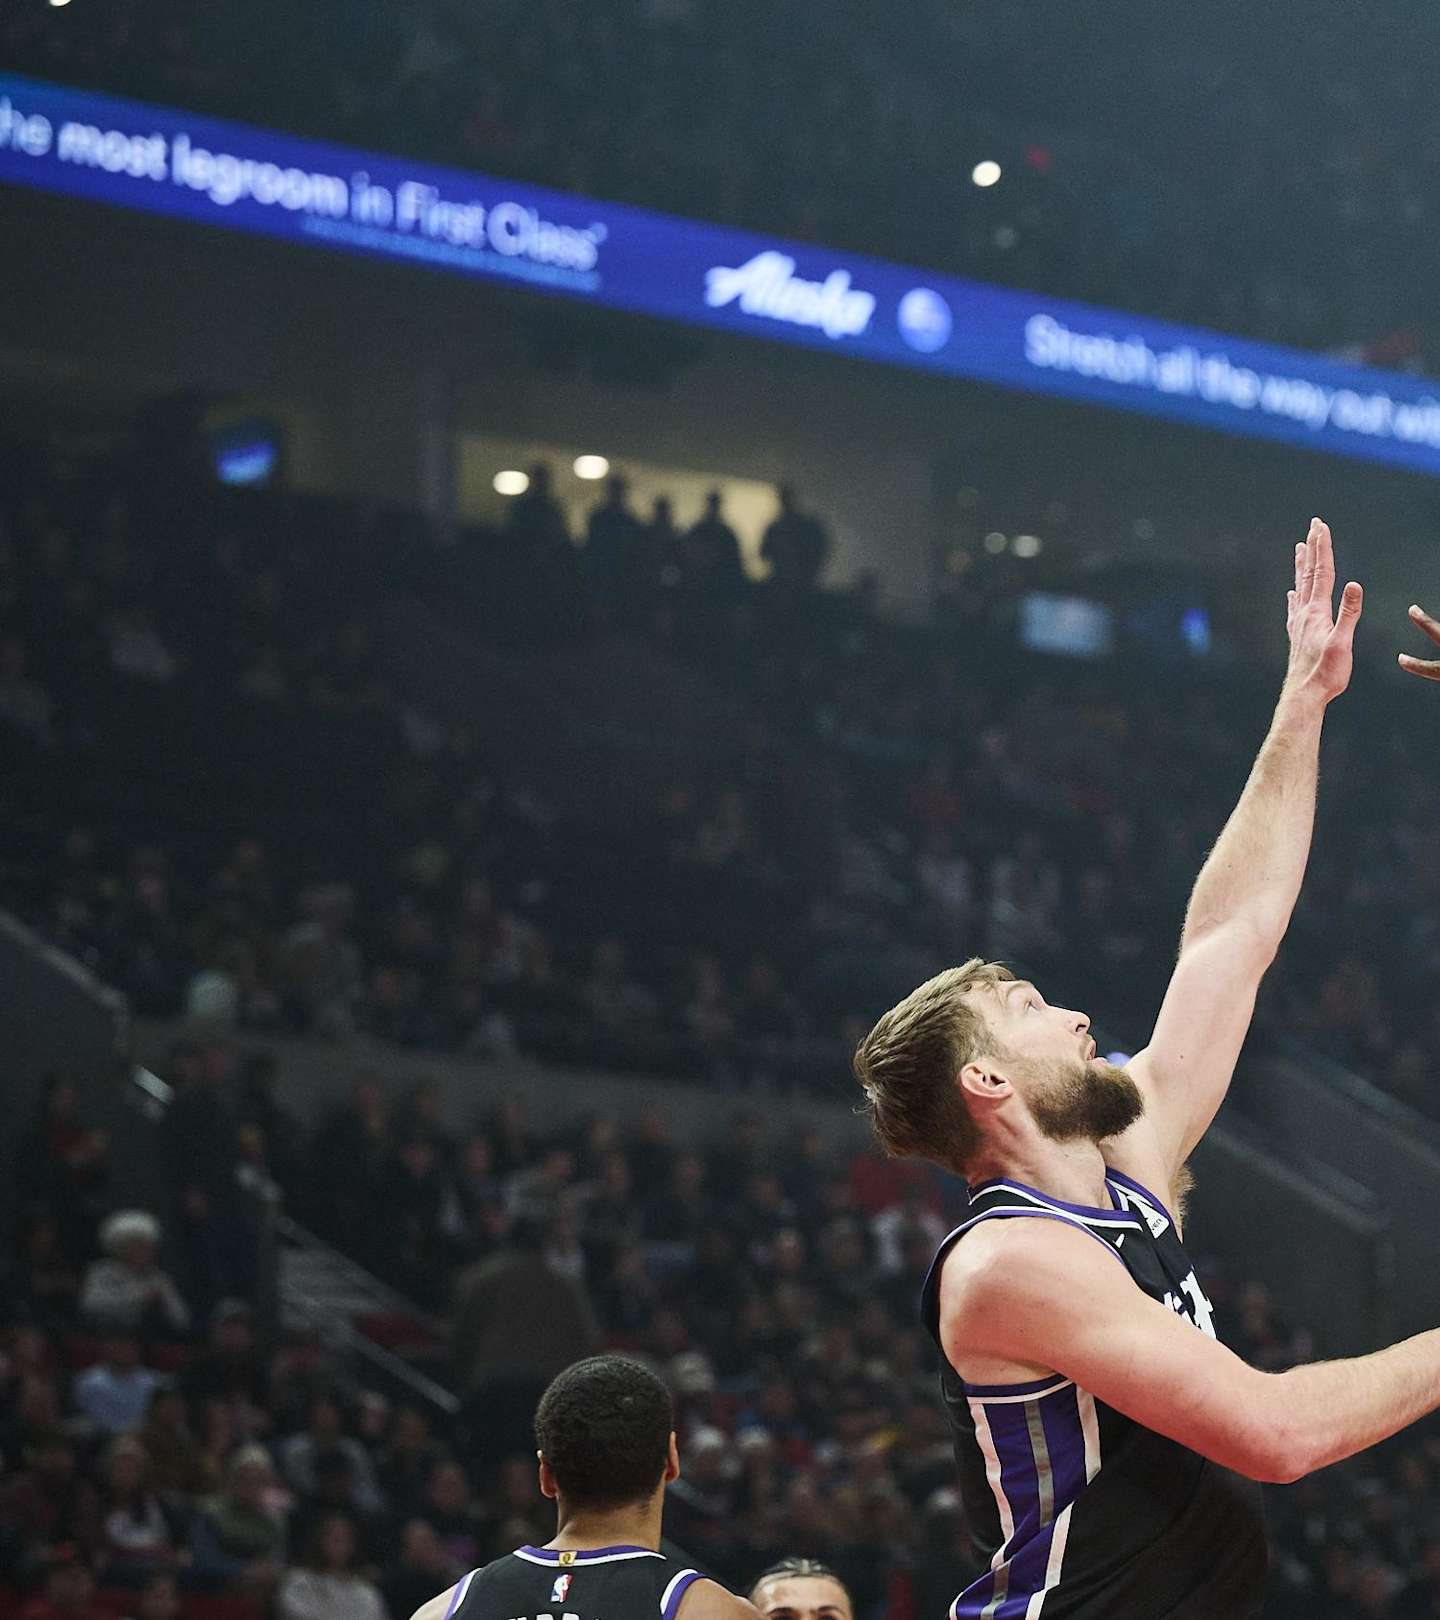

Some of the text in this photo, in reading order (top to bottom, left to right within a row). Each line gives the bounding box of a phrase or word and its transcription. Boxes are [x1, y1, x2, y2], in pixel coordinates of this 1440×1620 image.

[58, 122, 168, 182] most
[172, 132, 349, 220] legroom
[350, 170, 394, 227] in
[396, 181, 487, 249] First
[1024, 313, 1157, 387] Stretch
[1154, 344, 1198, 395] all
[1198, 352, 1262, 411] the
[1261, 376, 1329, 430] way
[1329, 388, 1394, 438] out
